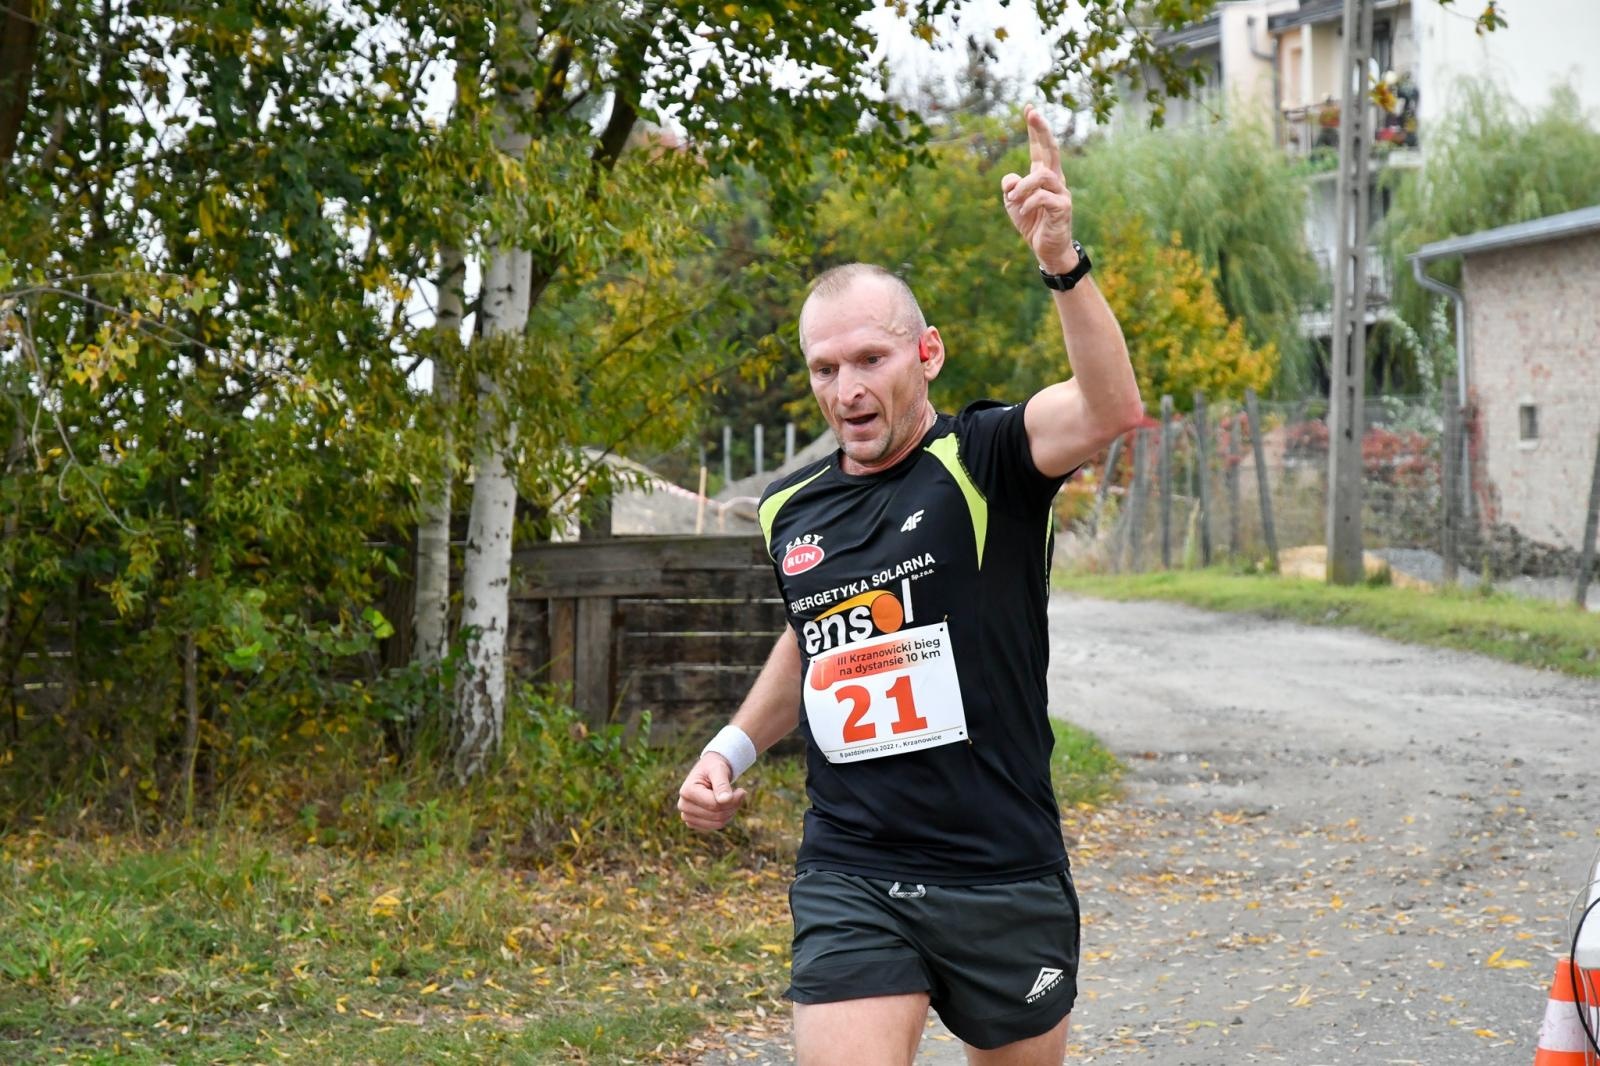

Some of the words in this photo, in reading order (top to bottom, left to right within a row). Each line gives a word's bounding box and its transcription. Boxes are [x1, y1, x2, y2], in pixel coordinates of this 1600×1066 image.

[785, 534, 823, 553] EASY
[787, 552, 816, 568] RUN
[791, 581, 869, 613] ENERGETYKA
[872, 553, 936, 586] SOLARNA
[837, 656, 847, 665] III
[850, 642, 911, 662] Krzanowicki
[915, 638, 941, 650] bieg
[840, 667, 852, 676] na
[855, 656, 903, 674] dystansie
[906, 653, 918, 663] 10
[921, 650, 941, 660] km
[834, 675, 928, 743] 21
[880, 743, 894, 751] 2022
[903, 735, 942, 747] Krzanowice
[1026, 986, 1045, 1004] NIKE
[1047, 974, 1065, 991] TRAIL
